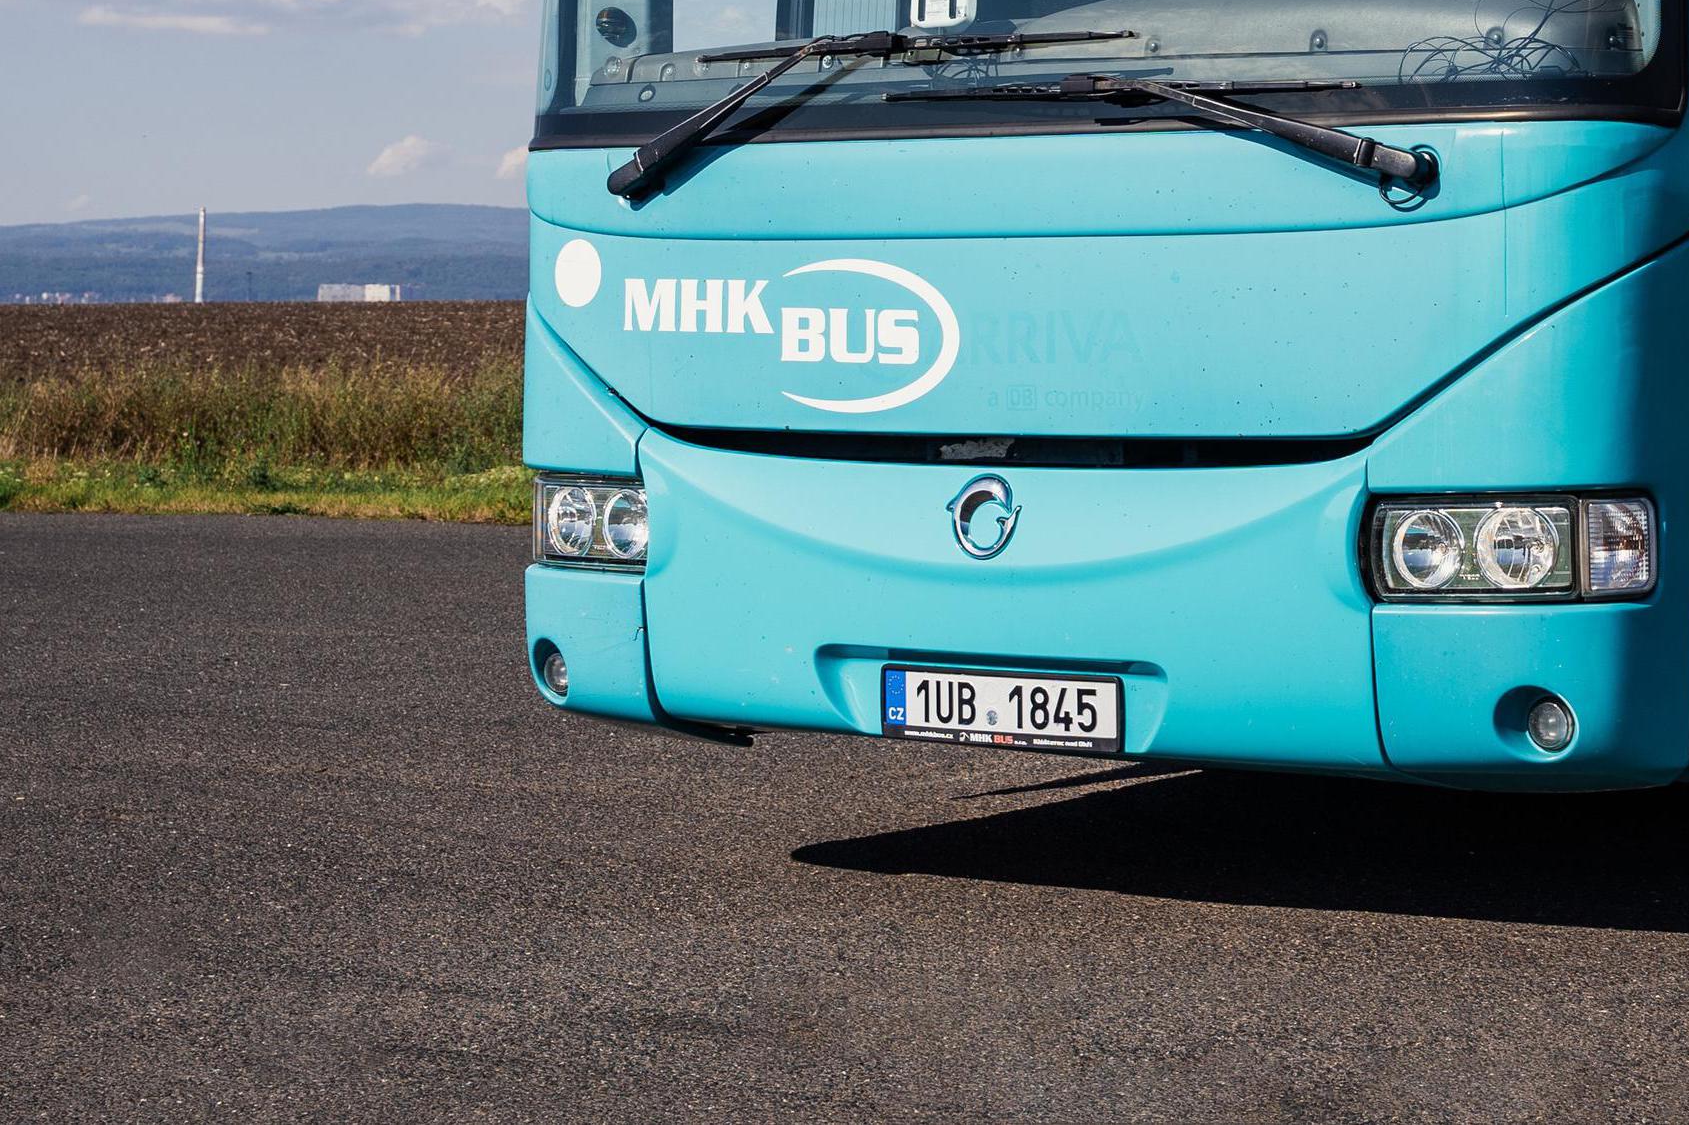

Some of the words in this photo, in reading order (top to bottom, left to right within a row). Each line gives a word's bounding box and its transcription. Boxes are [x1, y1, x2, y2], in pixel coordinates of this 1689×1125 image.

[623, 278, 775, 334] MHK
[780, 308, 921, 365] BUS
[1044, 388, 1145, 412] company
[888, 706, 905, 721] CZ
[916, 679, 977, 726] 1UB
[1008, 684, 1098, 733] 1845
[969, 732, 993, 743] MHK
[993, 734, 1014, 745] BUS
